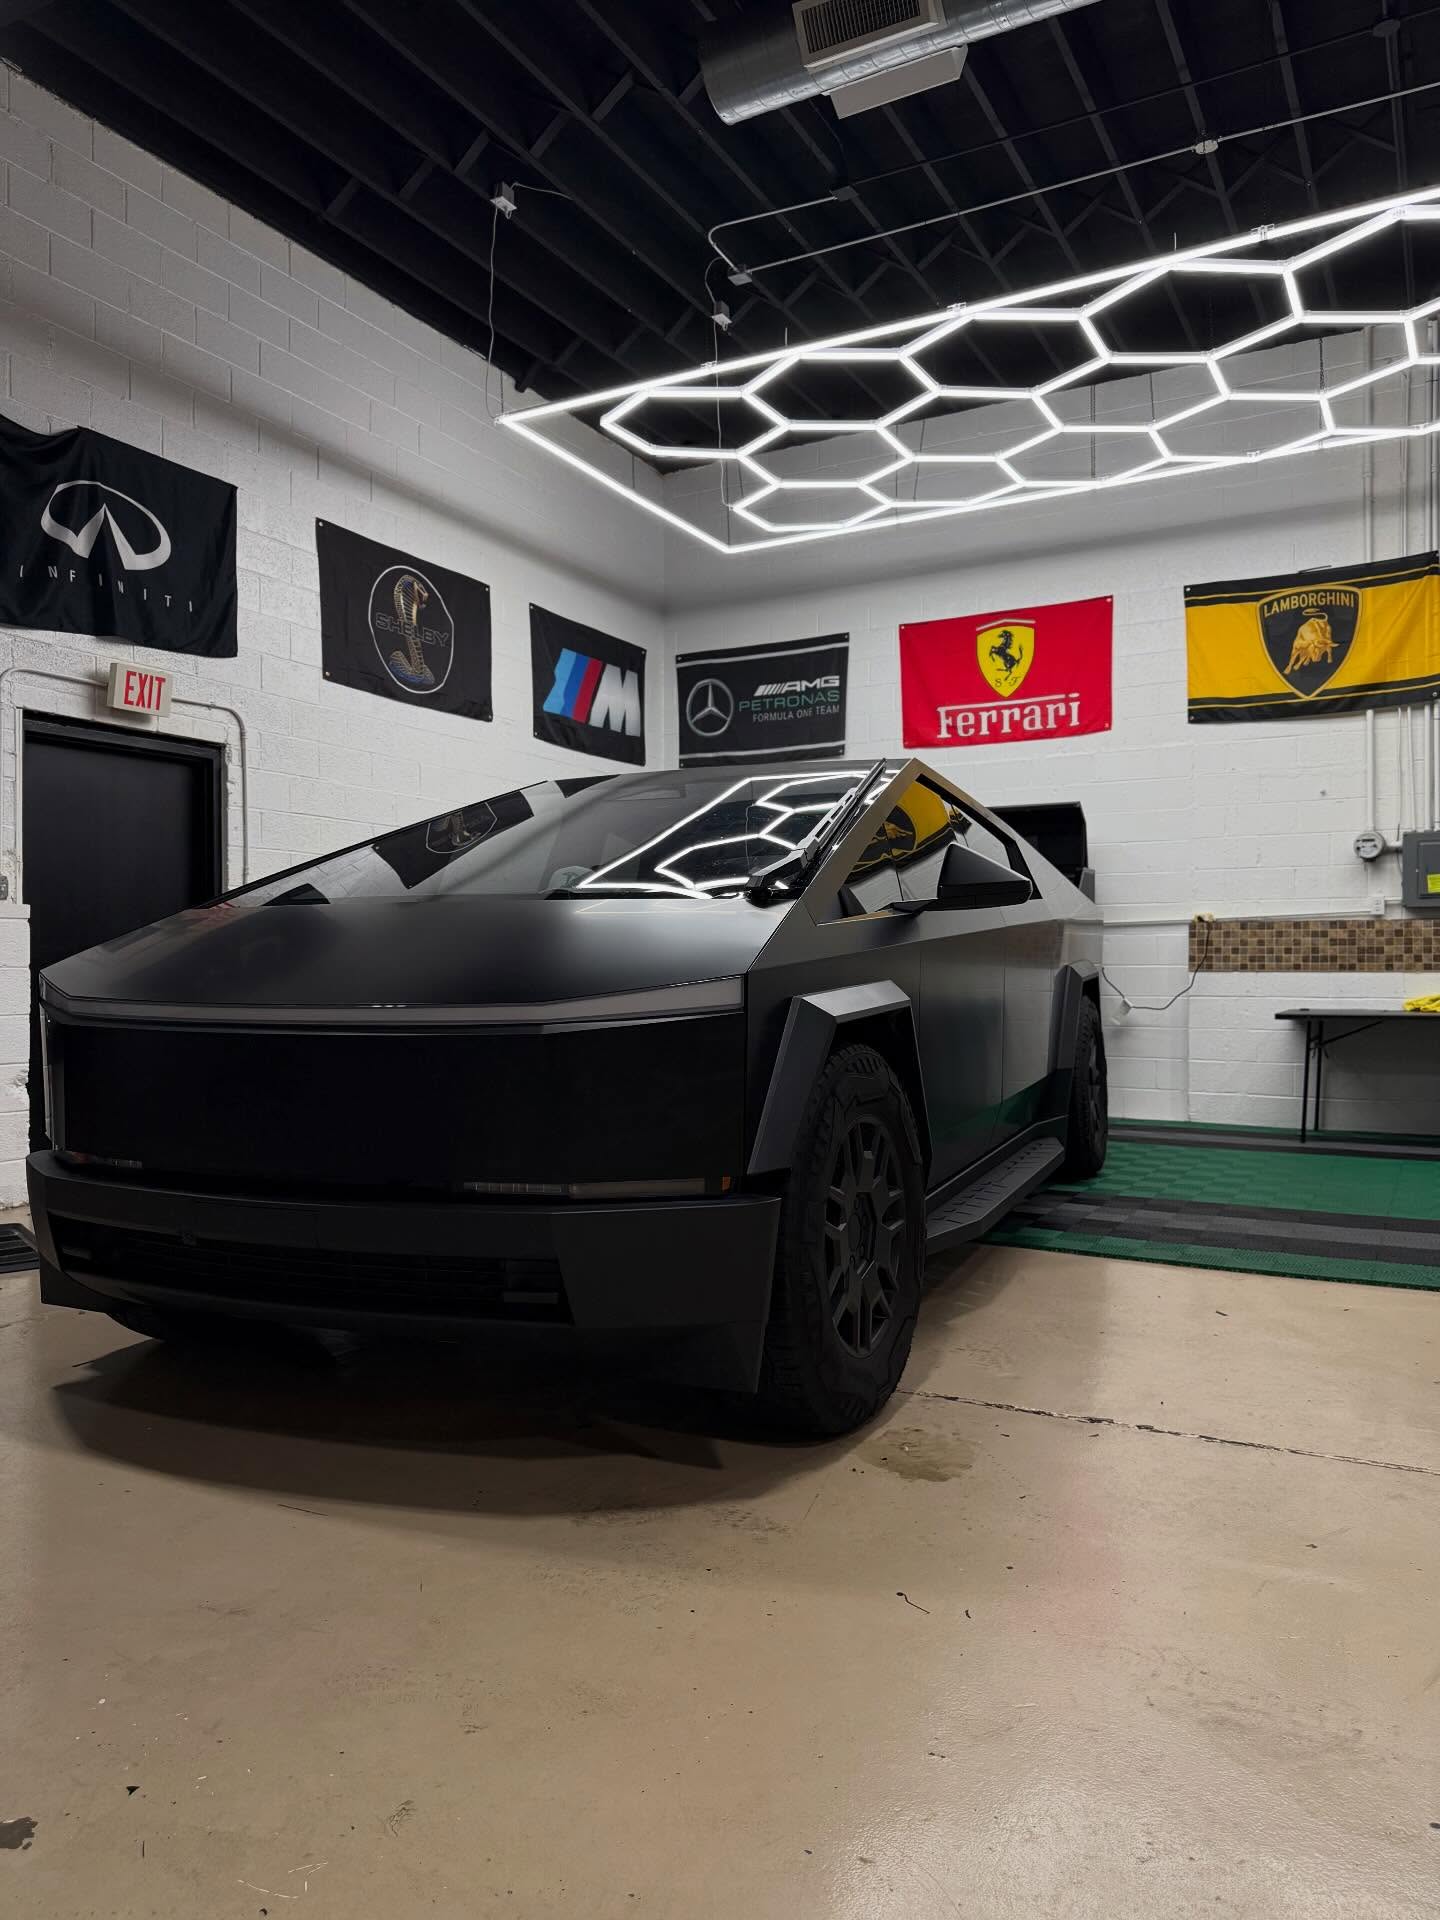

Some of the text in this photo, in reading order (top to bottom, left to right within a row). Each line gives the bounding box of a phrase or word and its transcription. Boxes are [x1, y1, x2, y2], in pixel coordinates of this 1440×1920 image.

[19, 564, 195, 612] INFINITI
[1263, 591, 1356, 618] LAMBORGHINI
[375, 611, 450, 648] SHELBY
[123, 669, 167, 711] EXIT
[738, 690, 841, 712] PETRONAS
[752, 704, 840, 723] FORMULA ONE TEAM
[936, 692, 1081, 739] Ferrari
